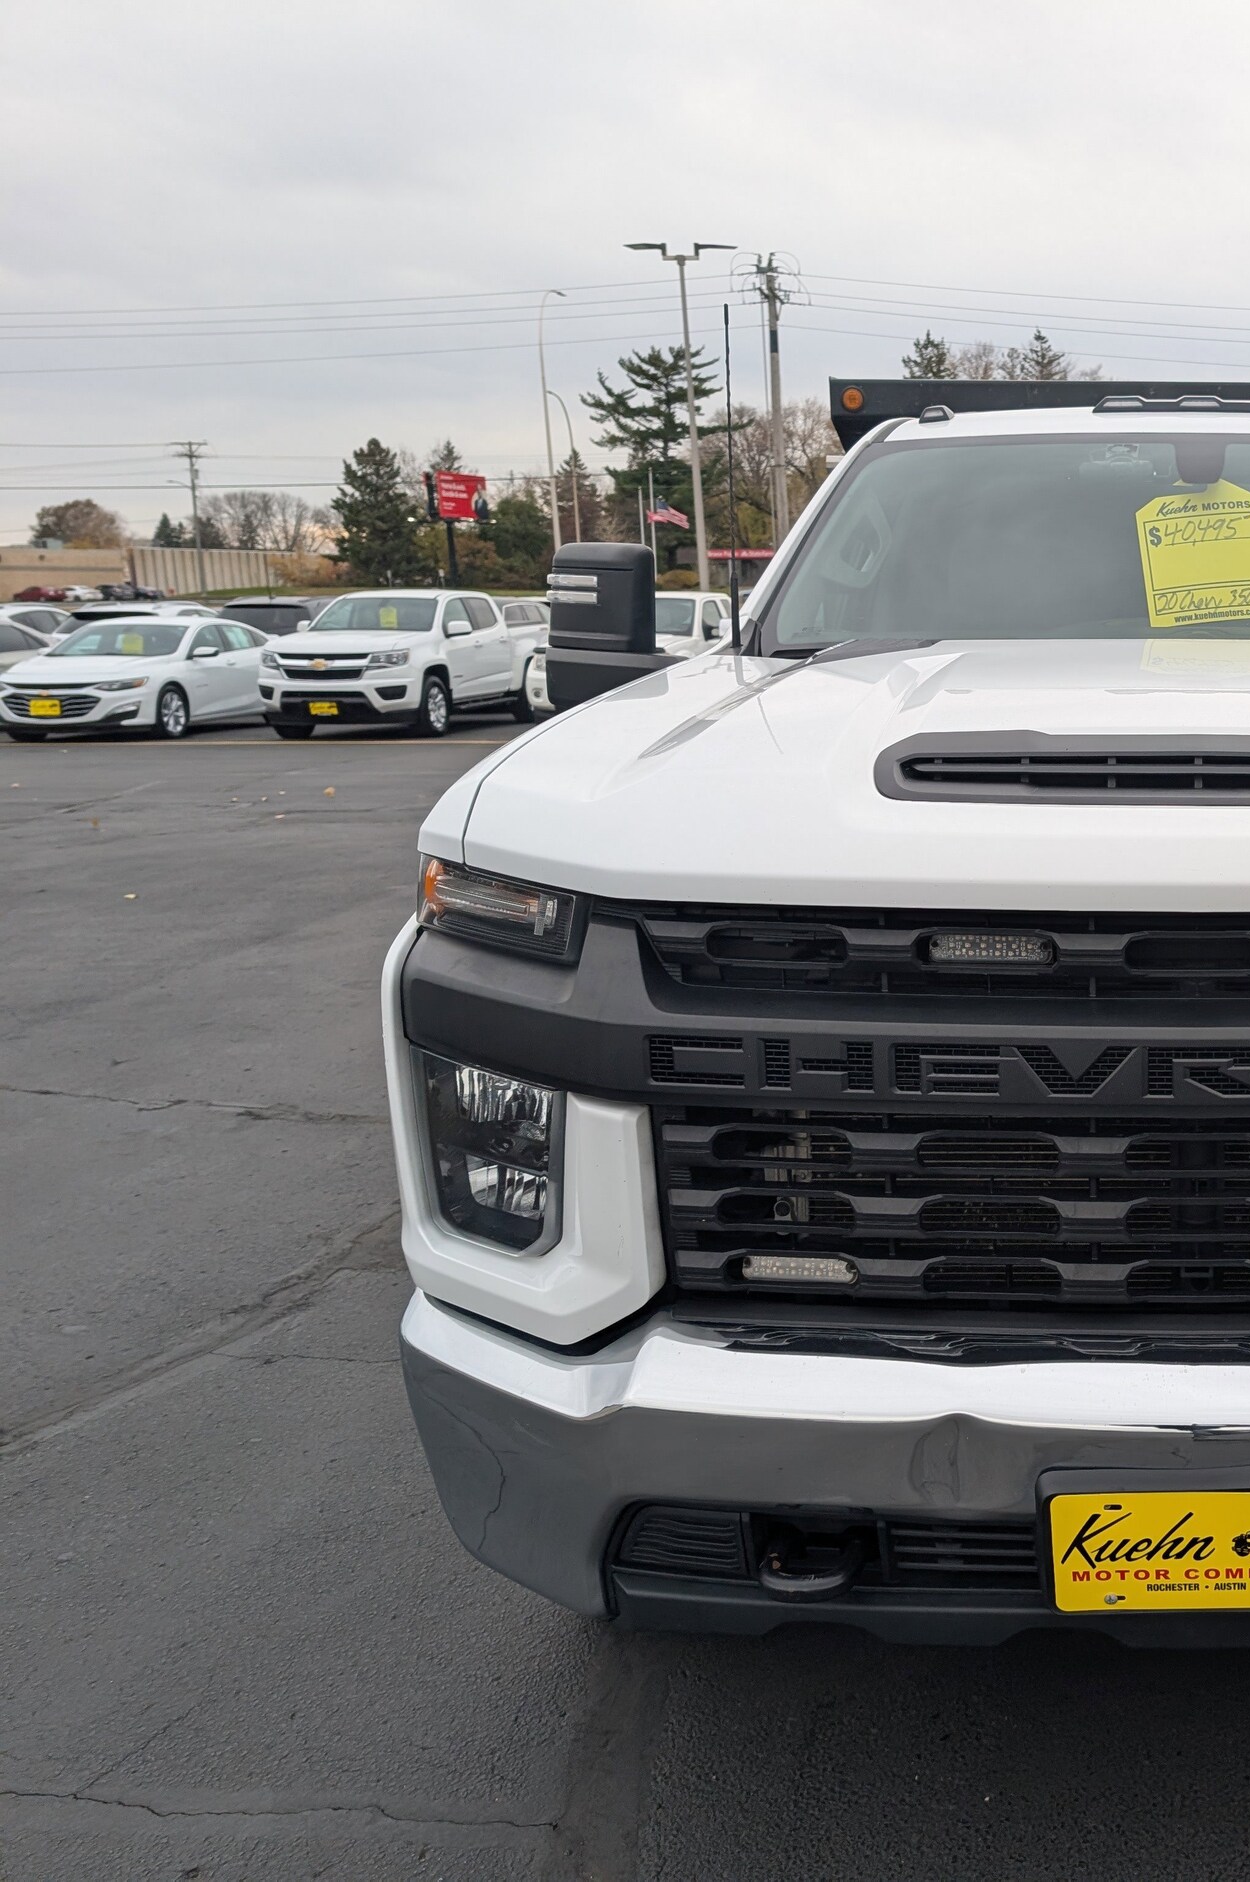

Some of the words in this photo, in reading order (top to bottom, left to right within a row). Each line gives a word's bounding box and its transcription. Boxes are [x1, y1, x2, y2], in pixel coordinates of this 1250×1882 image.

[1156, 499, 1198, 517] Kuehn
[1201, 501, 1250, 511] MOTORS
[1157, 593, 1178, 612] 20
[1061, 1512, 1215, 1569] Kuehn
[1072, 1569, 1170, 1582] MOTOR
[1147, 1583, 1200, 1592] ROCHESTER
[1214, 1582, 1247, 1591] AUSTIN
